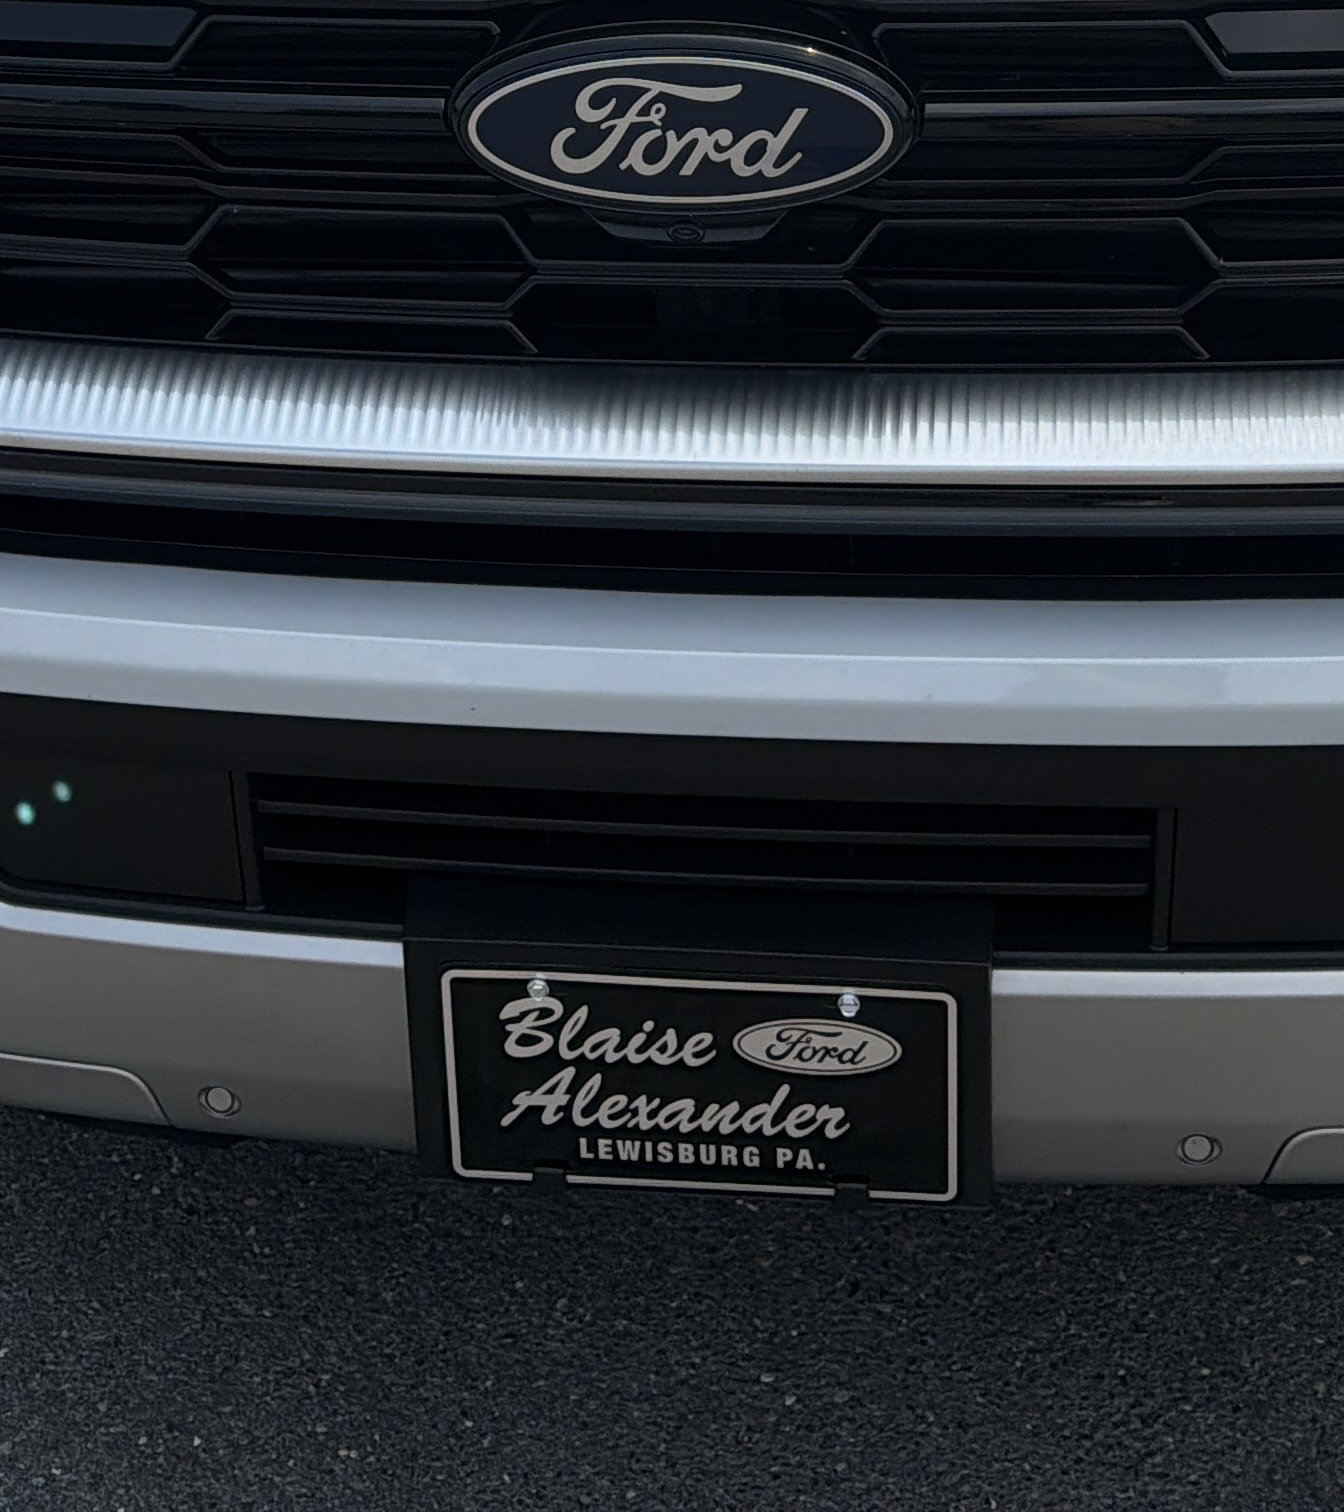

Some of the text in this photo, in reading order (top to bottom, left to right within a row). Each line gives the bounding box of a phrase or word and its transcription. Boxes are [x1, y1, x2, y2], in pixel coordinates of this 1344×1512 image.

[549, 77, 809, 177] Ford
[498, 997, 870, 1066] Blaise Ford
[500, 1066, 850, 1139] Alexander
[578, 1137, 827, 1171] LEWISBURG PA.
